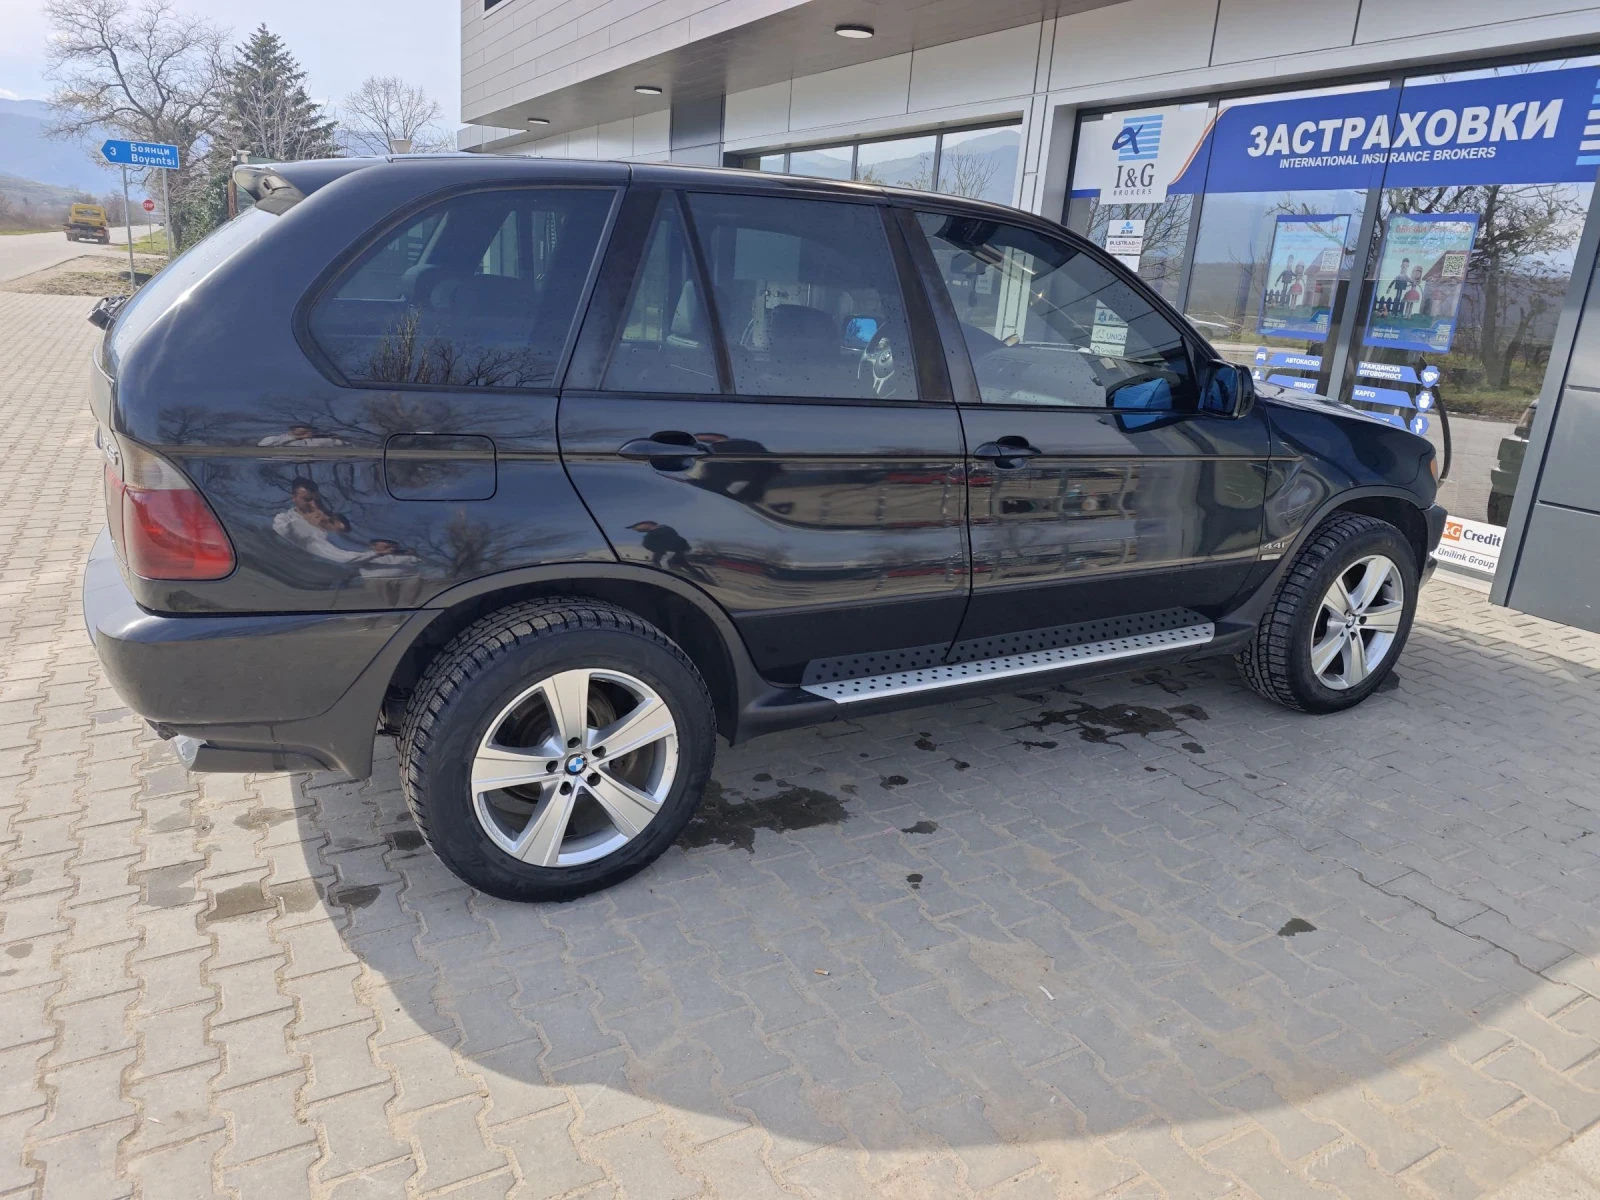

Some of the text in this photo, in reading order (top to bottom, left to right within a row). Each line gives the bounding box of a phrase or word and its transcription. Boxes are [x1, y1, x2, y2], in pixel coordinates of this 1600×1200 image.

[1247, 98, 1564, 157] ЗАСТРАХОВКИ
[110, 147, 116, 156] 3
[130, 143, 170, 155] Боянци
[131, 154, 175, 165] Boyantsi
[1279, 146, 1496, 168] INTERNATIONAL INSURANCE BROKERS
[1113, 188, 1152, 197] BROKERS
[1285, 357, 1320, 367] АВТОКАСКО
[1360, 362, 1400, 373] ГРАЖДАНСКА
[1359, 369, 1402, 381] ОТГОВОРНОСТ
[1293, 380, 1315, 390] ЖИВОТ
[1354, 389, 1376, 398] КАРГО
[1463, 528, 1502, 548] Credit
[1437, 547, 1468, 562] Unilink
[1468, 555, 1495, 570] Group
